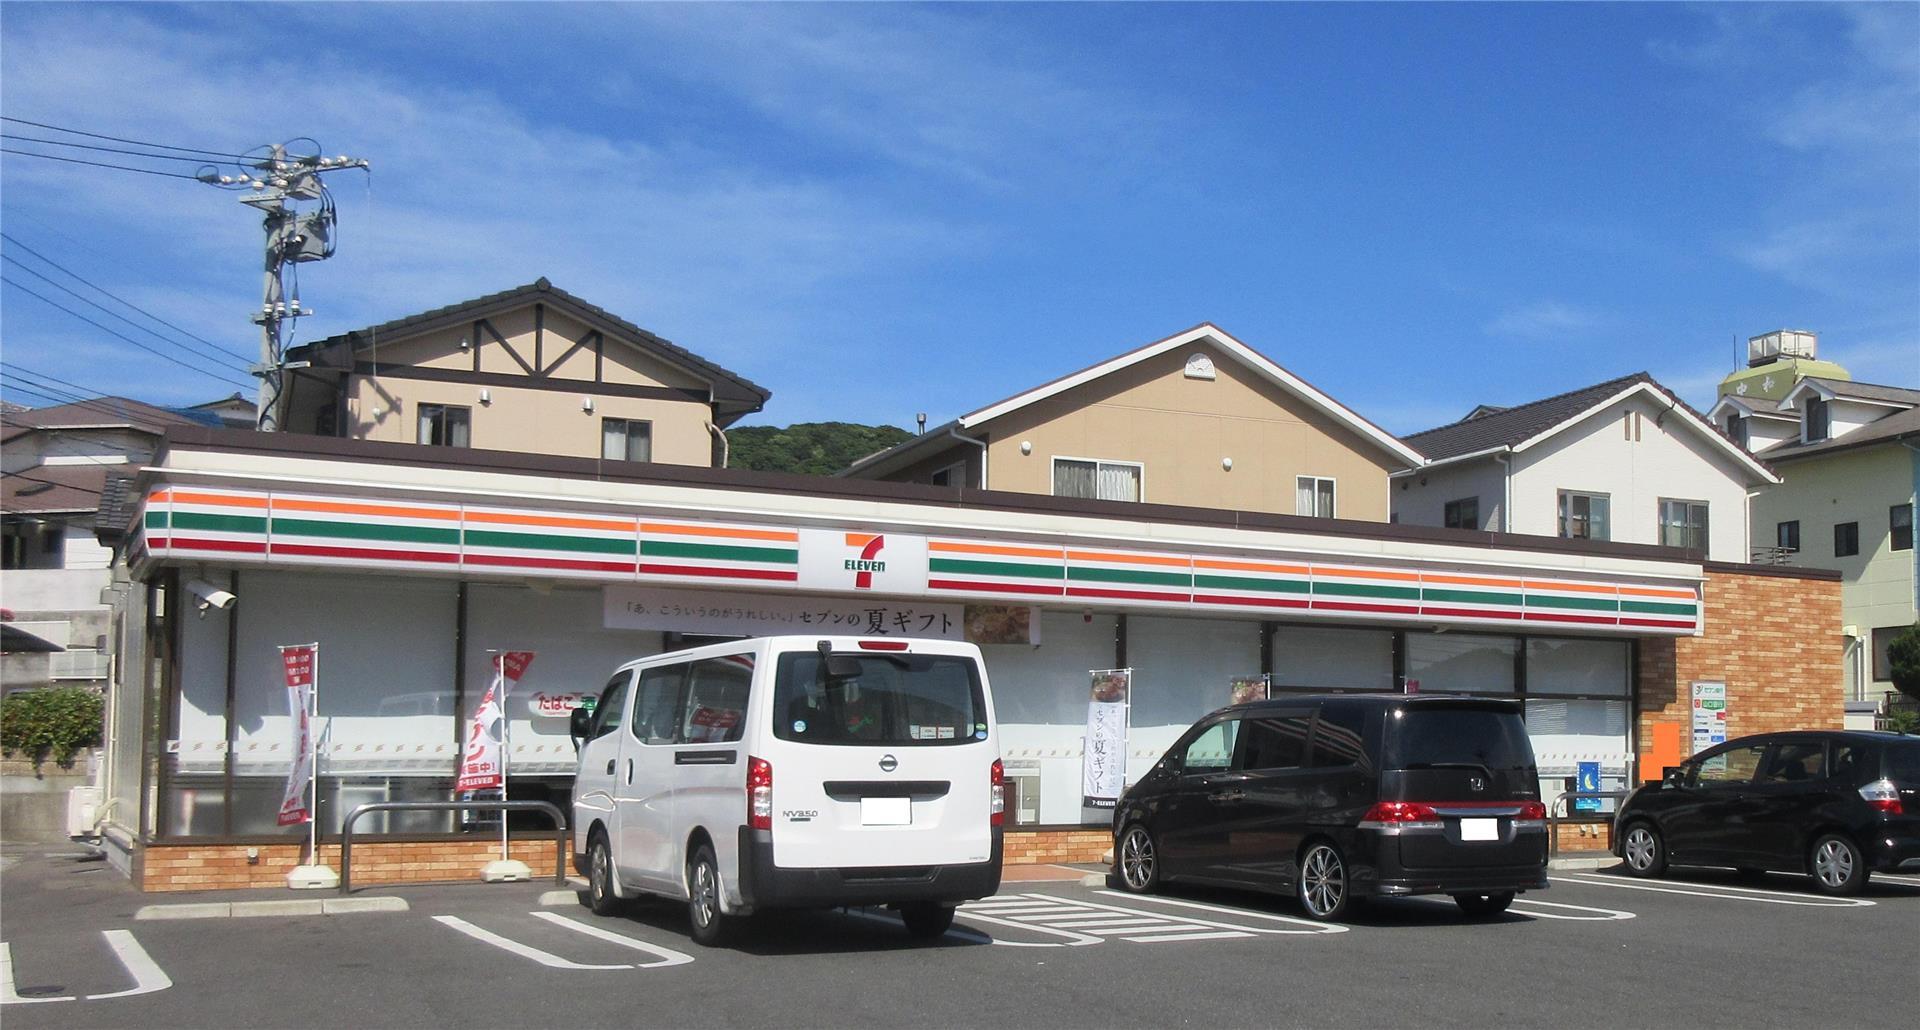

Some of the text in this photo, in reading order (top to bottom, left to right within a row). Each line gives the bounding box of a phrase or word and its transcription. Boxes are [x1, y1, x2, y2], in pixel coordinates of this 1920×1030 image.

[799, 607, 952, 635] セブンの夏ギフト
[538, 694, 574, 710] たばこ
[1093, 709, 1107, 794] セブンの夏ギフト
